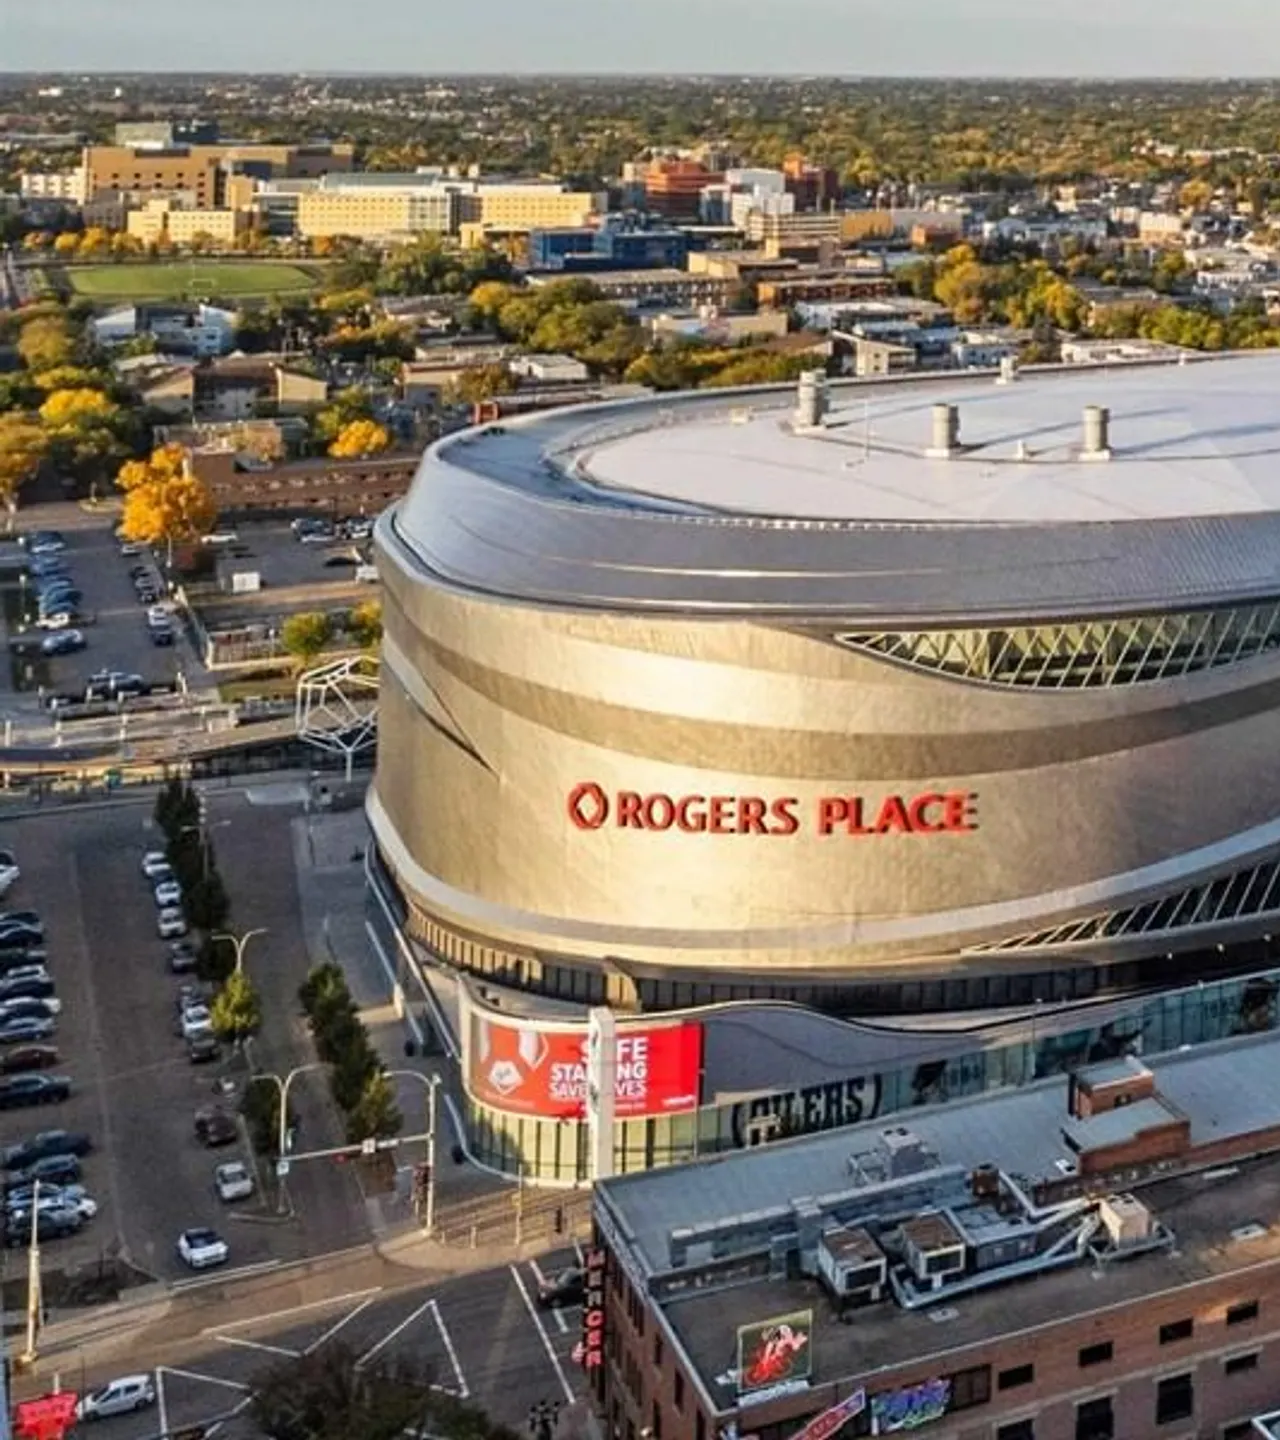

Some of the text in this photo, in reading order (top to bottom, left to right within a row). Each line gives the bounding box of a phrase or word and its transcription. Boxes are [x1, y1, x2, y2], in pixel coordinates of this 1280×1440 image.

[616, 790, 980, 835] ROGERS PLACE
[580, 1037, 648, 1063] SFE
